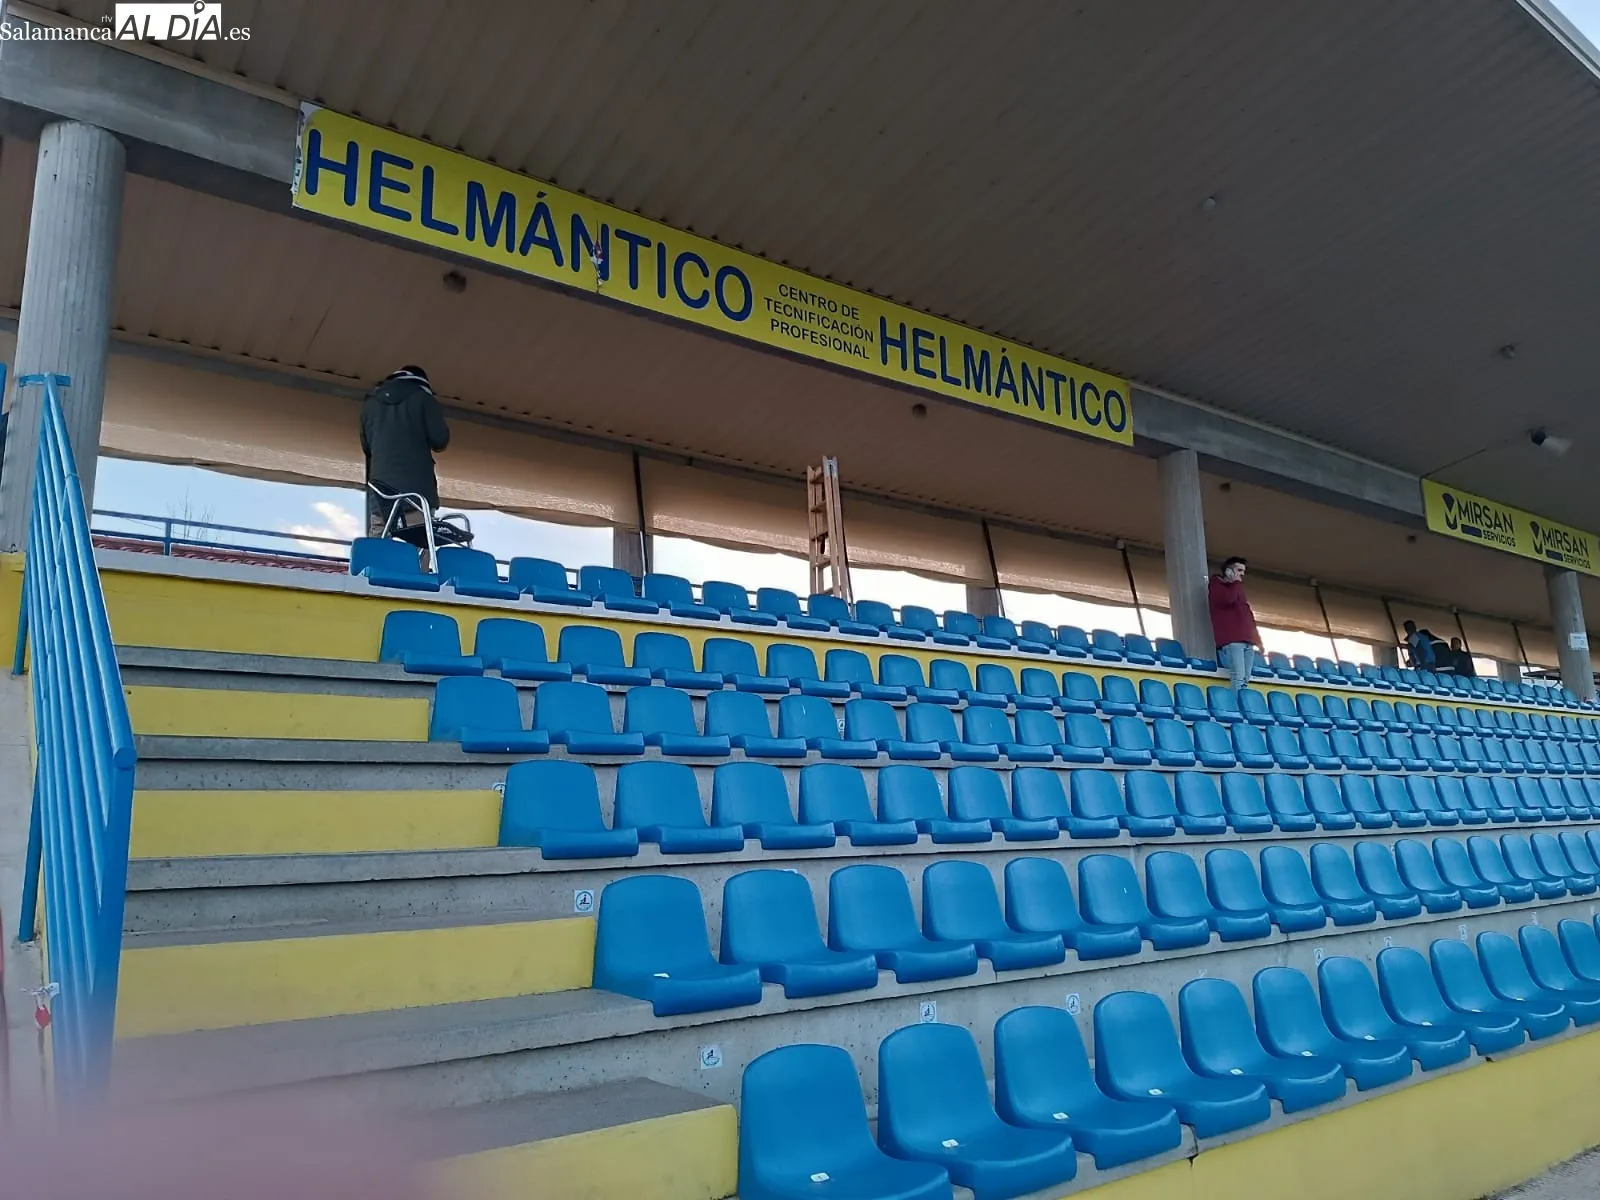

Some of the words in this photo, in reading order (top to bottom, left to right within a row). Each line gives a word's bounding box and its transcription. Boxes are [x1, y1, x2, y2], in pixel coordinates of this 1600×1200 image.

[305, 128, 753, 322] HELMÁNTICO
[763, 297, 874, 343] TECNIFICACIÓN
[778, 283, 838, 313] CENTRO
[841, 304, 860, 321] DE
[770, 318, 871, 360] PROFESIONAL
[878, 315, 1127, 433] HELMÁNTICO
[1456, 499, 1514, 534] MIRSAN
[1483, 529, 1516, 547] SERVICIOS
[1541, 527, 1589, 557] MIRSAN
[1563, 553, 1592, 569] SERVICIOS
